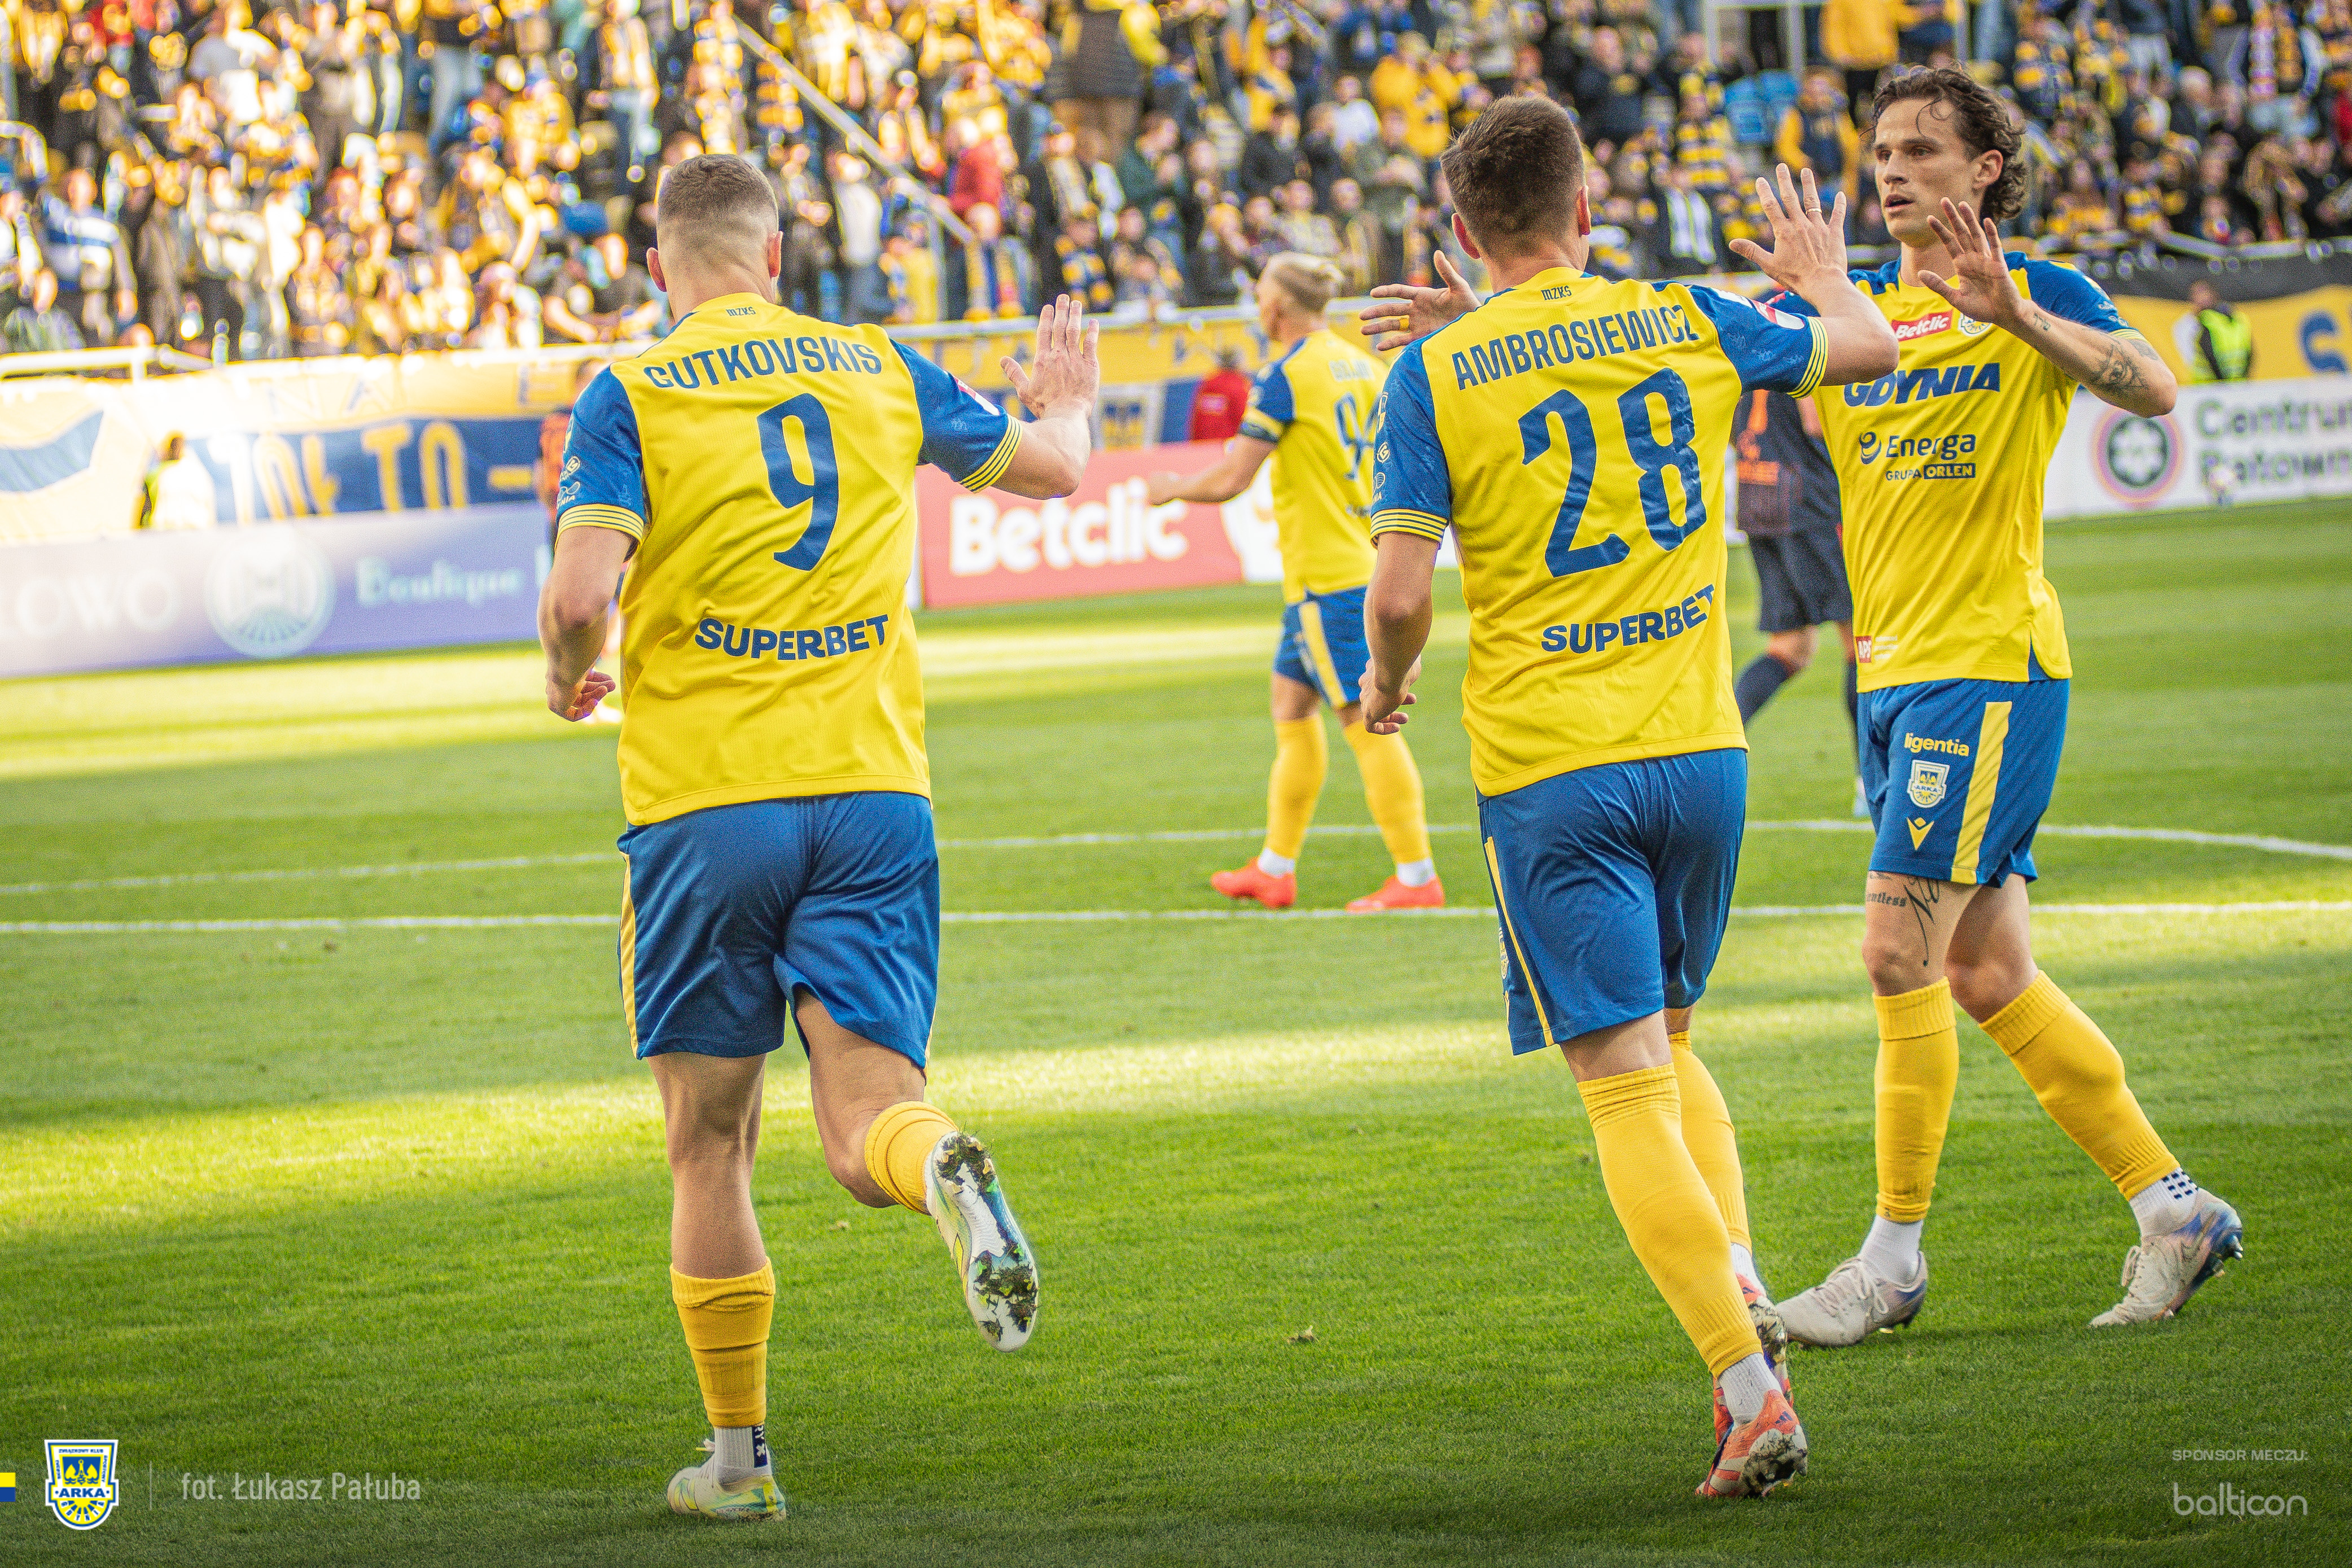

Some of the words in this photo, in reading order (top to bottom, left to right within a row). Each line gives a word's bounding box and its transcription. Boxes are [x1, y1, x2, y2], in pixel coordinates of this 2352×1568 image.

[1452, 304, 1699, 390] AMBROSIEWICZ
[1895, 314, 1950, 339] Betclic
[643, 336, 882, 389] GUTKOVSKIS
[1843, 362, 2001, 407] GDYNIA
[2196, 396, 2352, 441] Centru
[1886, 433, 1976, 461] Energa
[756, 393, 839, 571] 9
[1517, 367, 1708, 578] 28
[1885, 468, 1922, 481] GRUPA
[1926, 465, 1973, 478] ORLEN
[949, 478, 1189, 576] Betclic
[695, 614, 889, 661] SUPERBET
[1541, 584, 1715, 654] SUPERBET
[1904, 732, 1970, 757] ligentia
